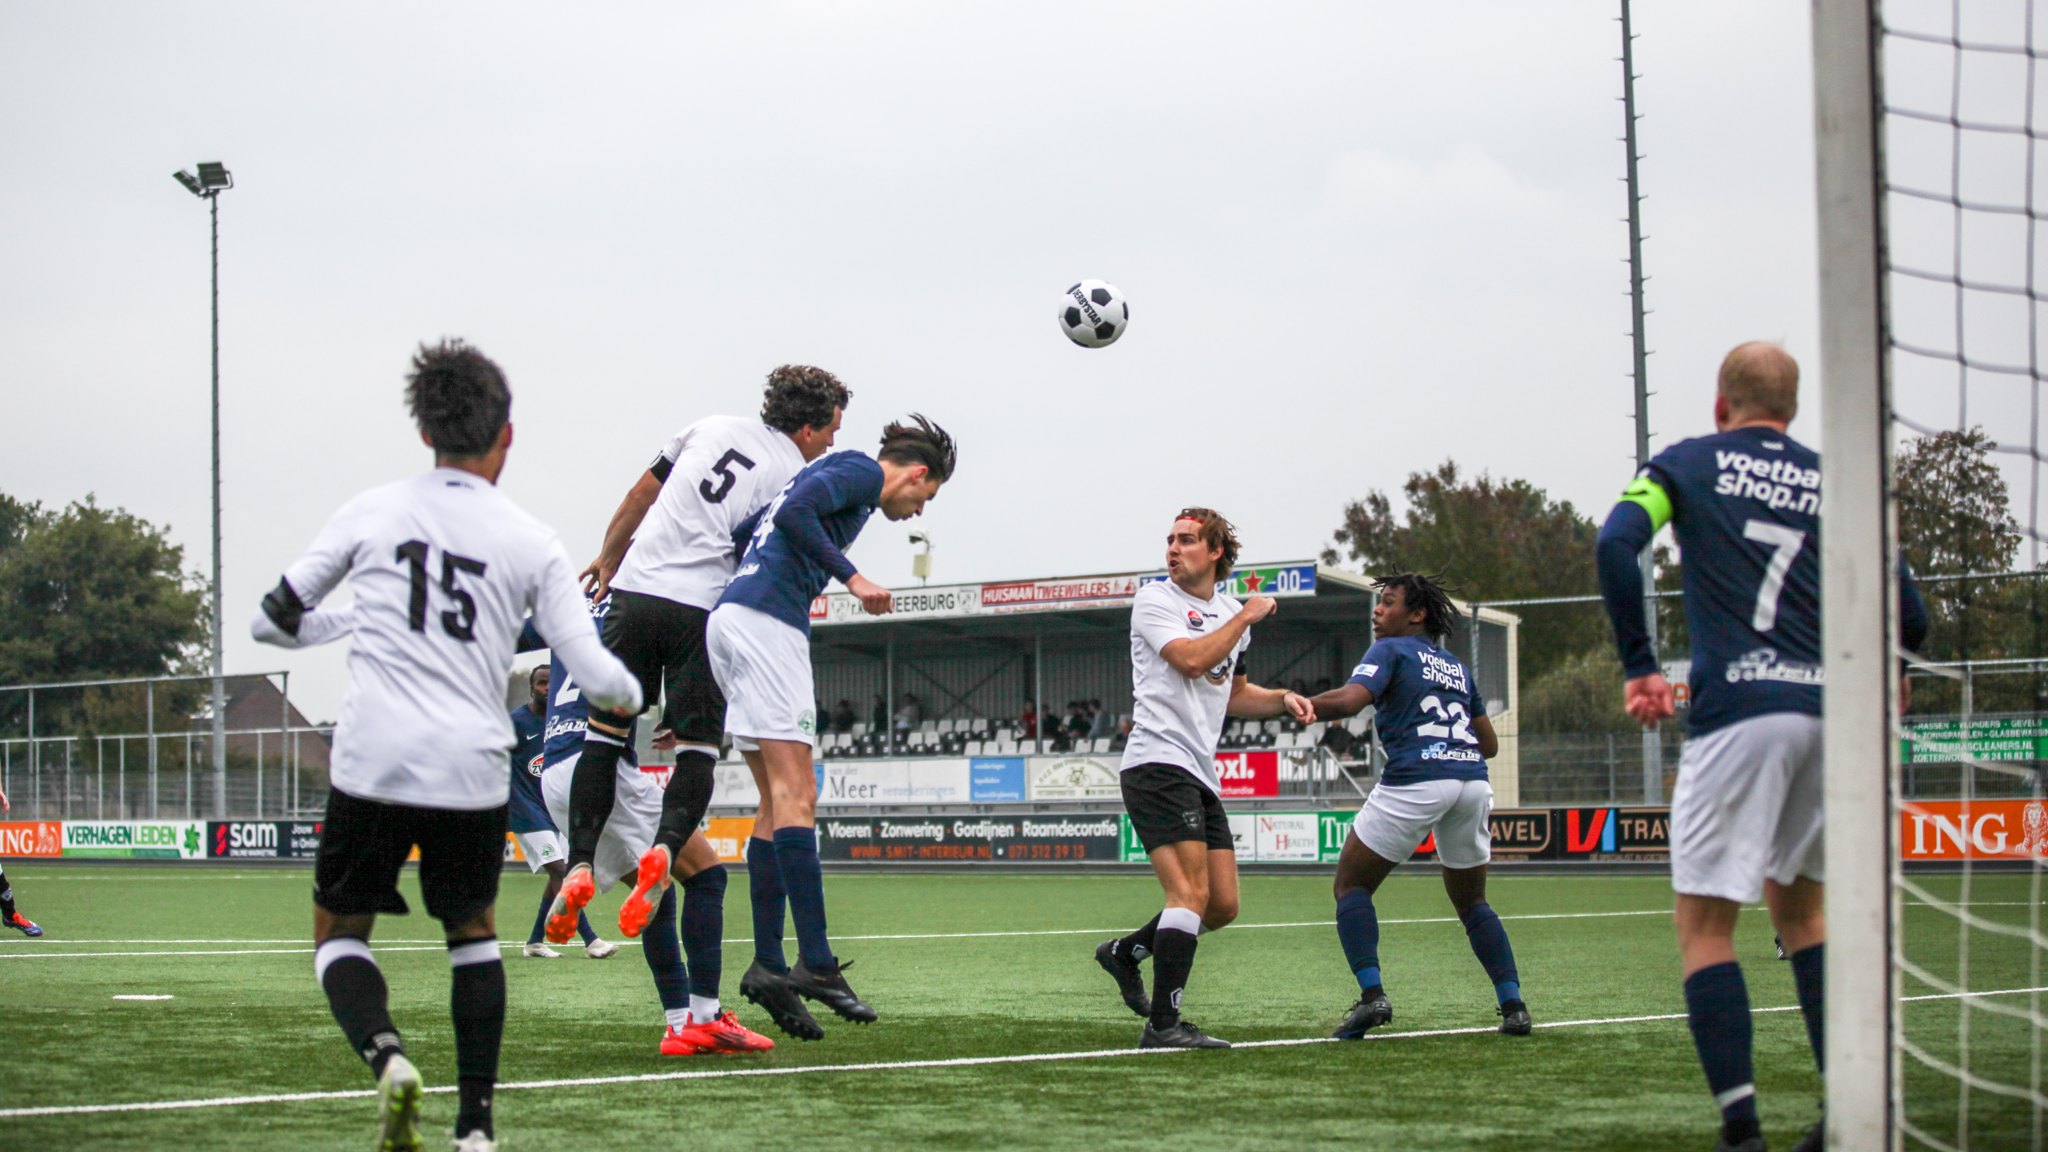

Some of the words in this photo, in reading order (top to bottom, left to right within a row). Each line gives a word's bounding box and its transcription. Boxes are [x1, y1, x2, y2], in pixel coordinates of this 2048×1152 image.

[699, 448, 756, 504] 5
[1715, 450, 1820, 490] voetba
[1714, 472, 1822, 516] shop.n
[1743, 519, 1805, 632] 7
[395, 539, 487, 643] 15
[893, 593, 956, 613] EERBURG
[982, 585, 1033, 603] HUISMAN
[1037, 581, 1110, 600] TWEEWIELERS
[1417, 651, 1464, 678] voetbal
[1422, 666, 1468, 694] shop.nl
[1417, 695, 1479, 744] 22
[829, 776, 877, 798] Meer
[67, 826, 132, 845] VERHAGEN
[134, 826, 177, 845] LEIDEN
[230, 823, 278, 848] sam
[828, 822, 871, 838] Vloeren
[881, 821, 944, 841] Zonwering
[954, 820, 1015, 841] Gordijnen
[1022, 819, 1117, 837] Raamdecoratie
[1490, 821, 1542, 841] AVEL
[1620, 818, 1673, 840] TRA
[1911, 813, 2009, 854] ING
[1008, 845, 1027, 858] 071
